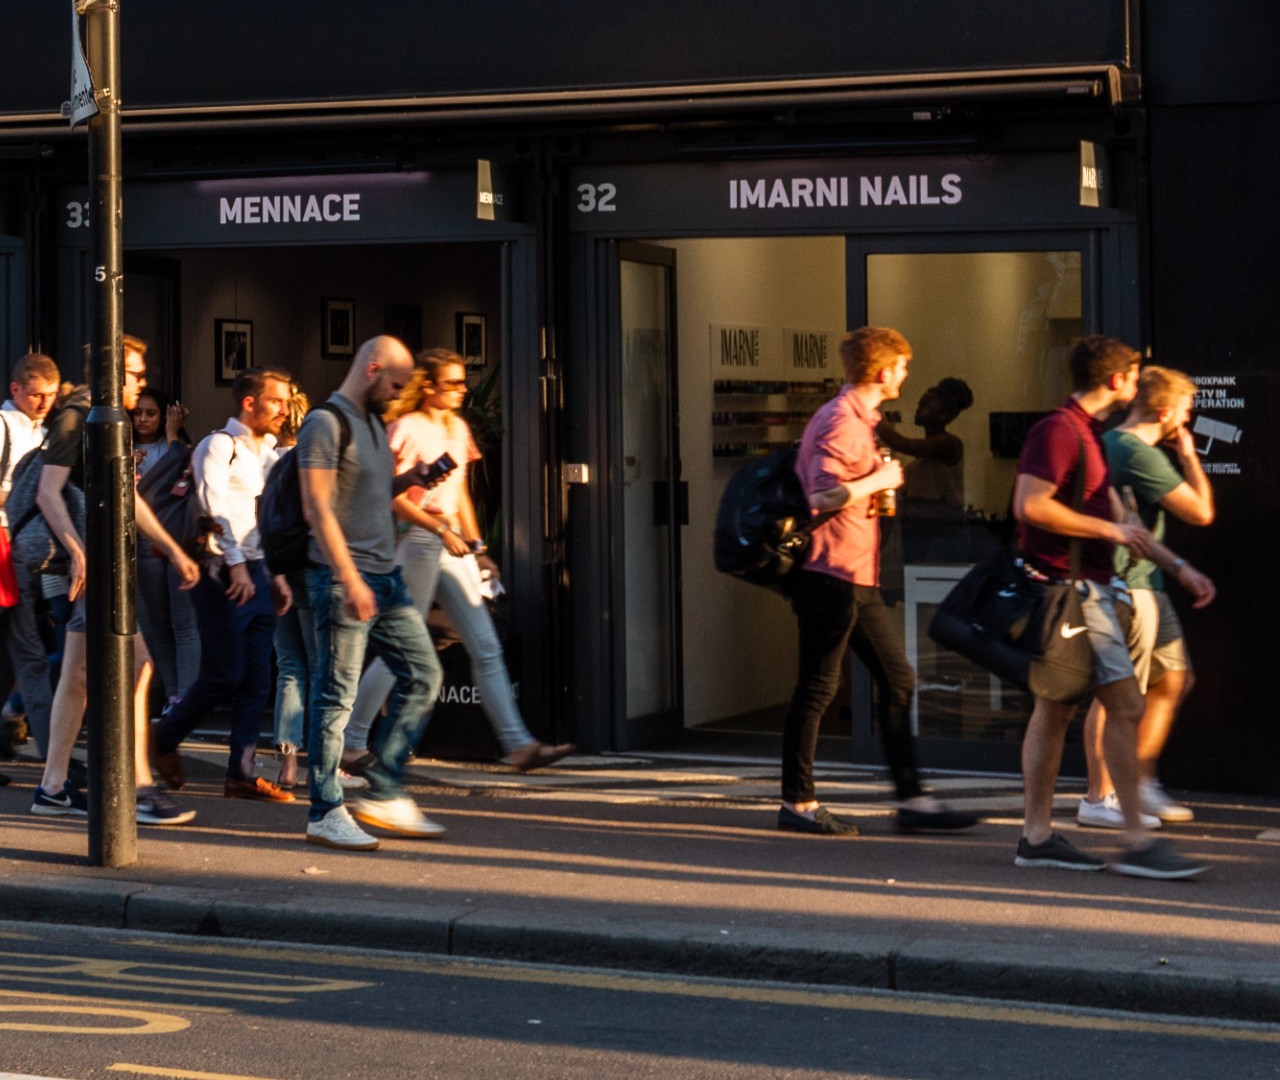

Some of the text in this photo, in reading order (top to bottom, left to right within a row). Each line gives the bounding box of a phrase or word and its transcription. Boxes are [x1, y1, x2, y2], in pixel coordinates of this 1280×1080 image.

[576, 183, 617, 213] 32
[729, 174, 963, 210] IMARNI NAILS
[219, 193, 361, 224] MENNACE
[94, 266, 106, 282] 5
[1216, 389, 1226, 398] IN
[1193, 398, 1245, 409] PERATION
[439, 685, 482, 704] NACE
